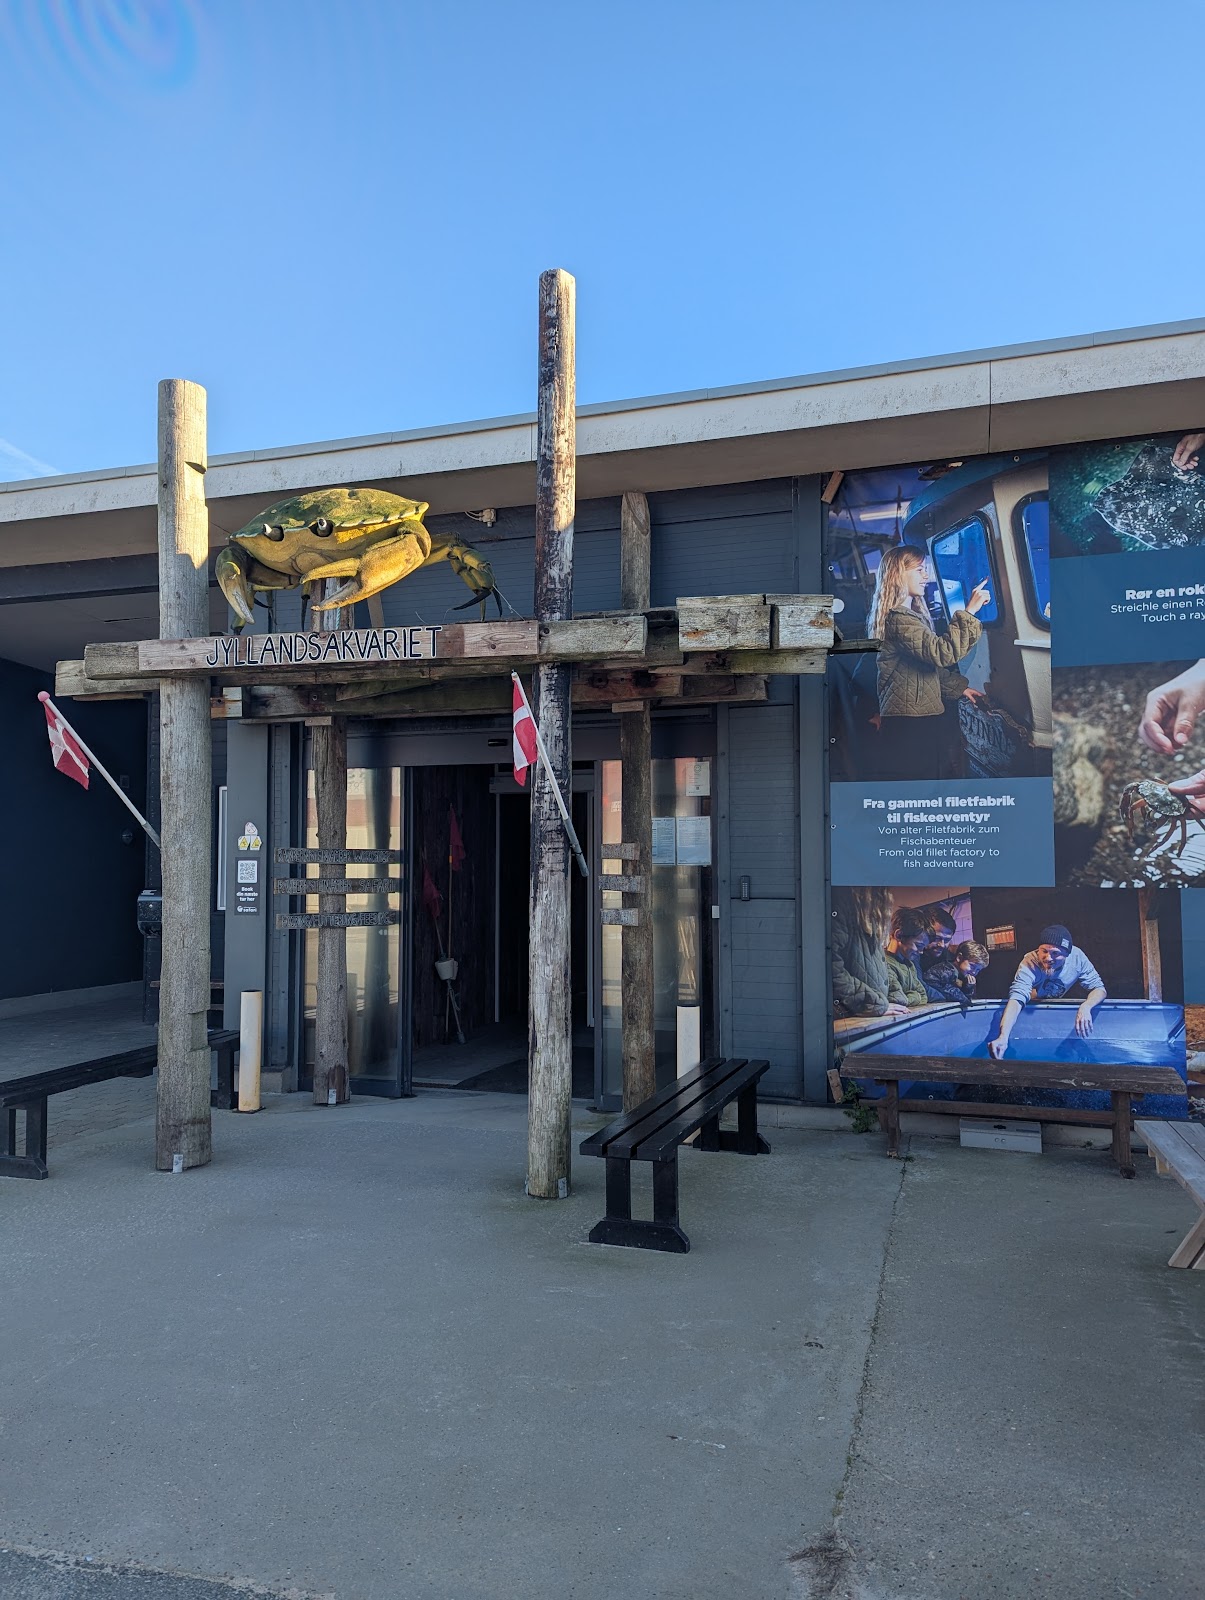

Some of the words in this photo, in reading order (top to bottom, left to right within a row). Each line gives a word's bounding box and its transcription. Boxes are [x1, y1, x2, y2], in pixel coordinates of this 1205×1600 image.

[1125, 589, 1152, 600] Rør
[1156, 588, 1175, 597] en
[1110, 603, 1158, 613] Streichle
[1162, 600, 1192, 609] einen
[1196, 598, 1205, 606] R
[1142, 613, 1176, 622] Touch
[206, 626, 442, 667] JYLLANDSAKVARIET
[863, 798, 885, 809] Fra
[888, 796, 943, 810] gammel
[945, 795, 1016, 807] filetfabrik
[887, 812, 901, 823] til
[904, 811, 991, 823] fiskeeventyr
[878, 826, 898, 835] Von
[900, 825, 923, 834] alter
[925, 825, 976, 834] Filetfabrik
[900, 837, 977, 845] Fischabenteuer
[879, 849, 905, 857] From
[907, 848, 923, 857] old
[926, 848, 947, 857] fillet
[950, 848, 986, 859] factory
[989, 849, 1000, 857] to
[903, 860, 921, 868] fish
[923, 860, 975, 868] adventure
